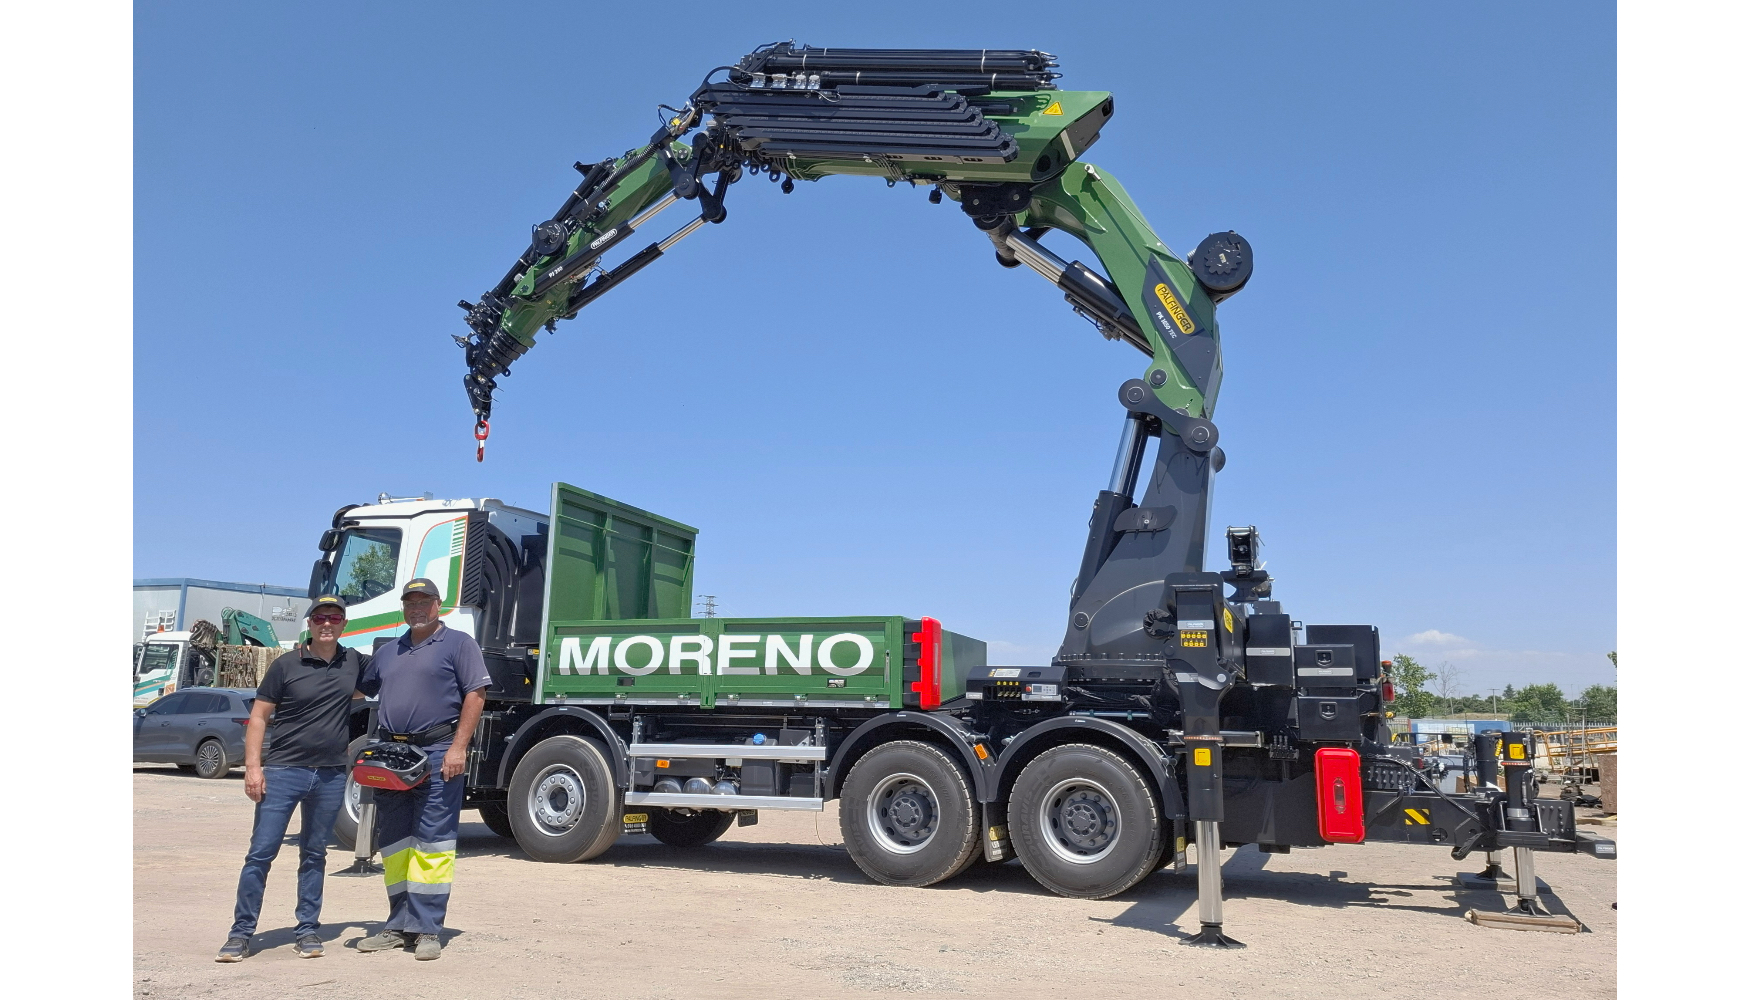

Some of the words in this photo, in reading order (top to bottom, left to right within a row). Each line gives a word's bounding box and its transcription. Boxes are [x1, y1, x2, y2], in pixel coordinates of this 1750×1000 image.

[1156, 311, 1164, 320] PK
[1168, 328, 1178, 339] TEC
[1157, 286, 1192, 332] PALFINGER
[558, 632, 874, 676] MORENO
